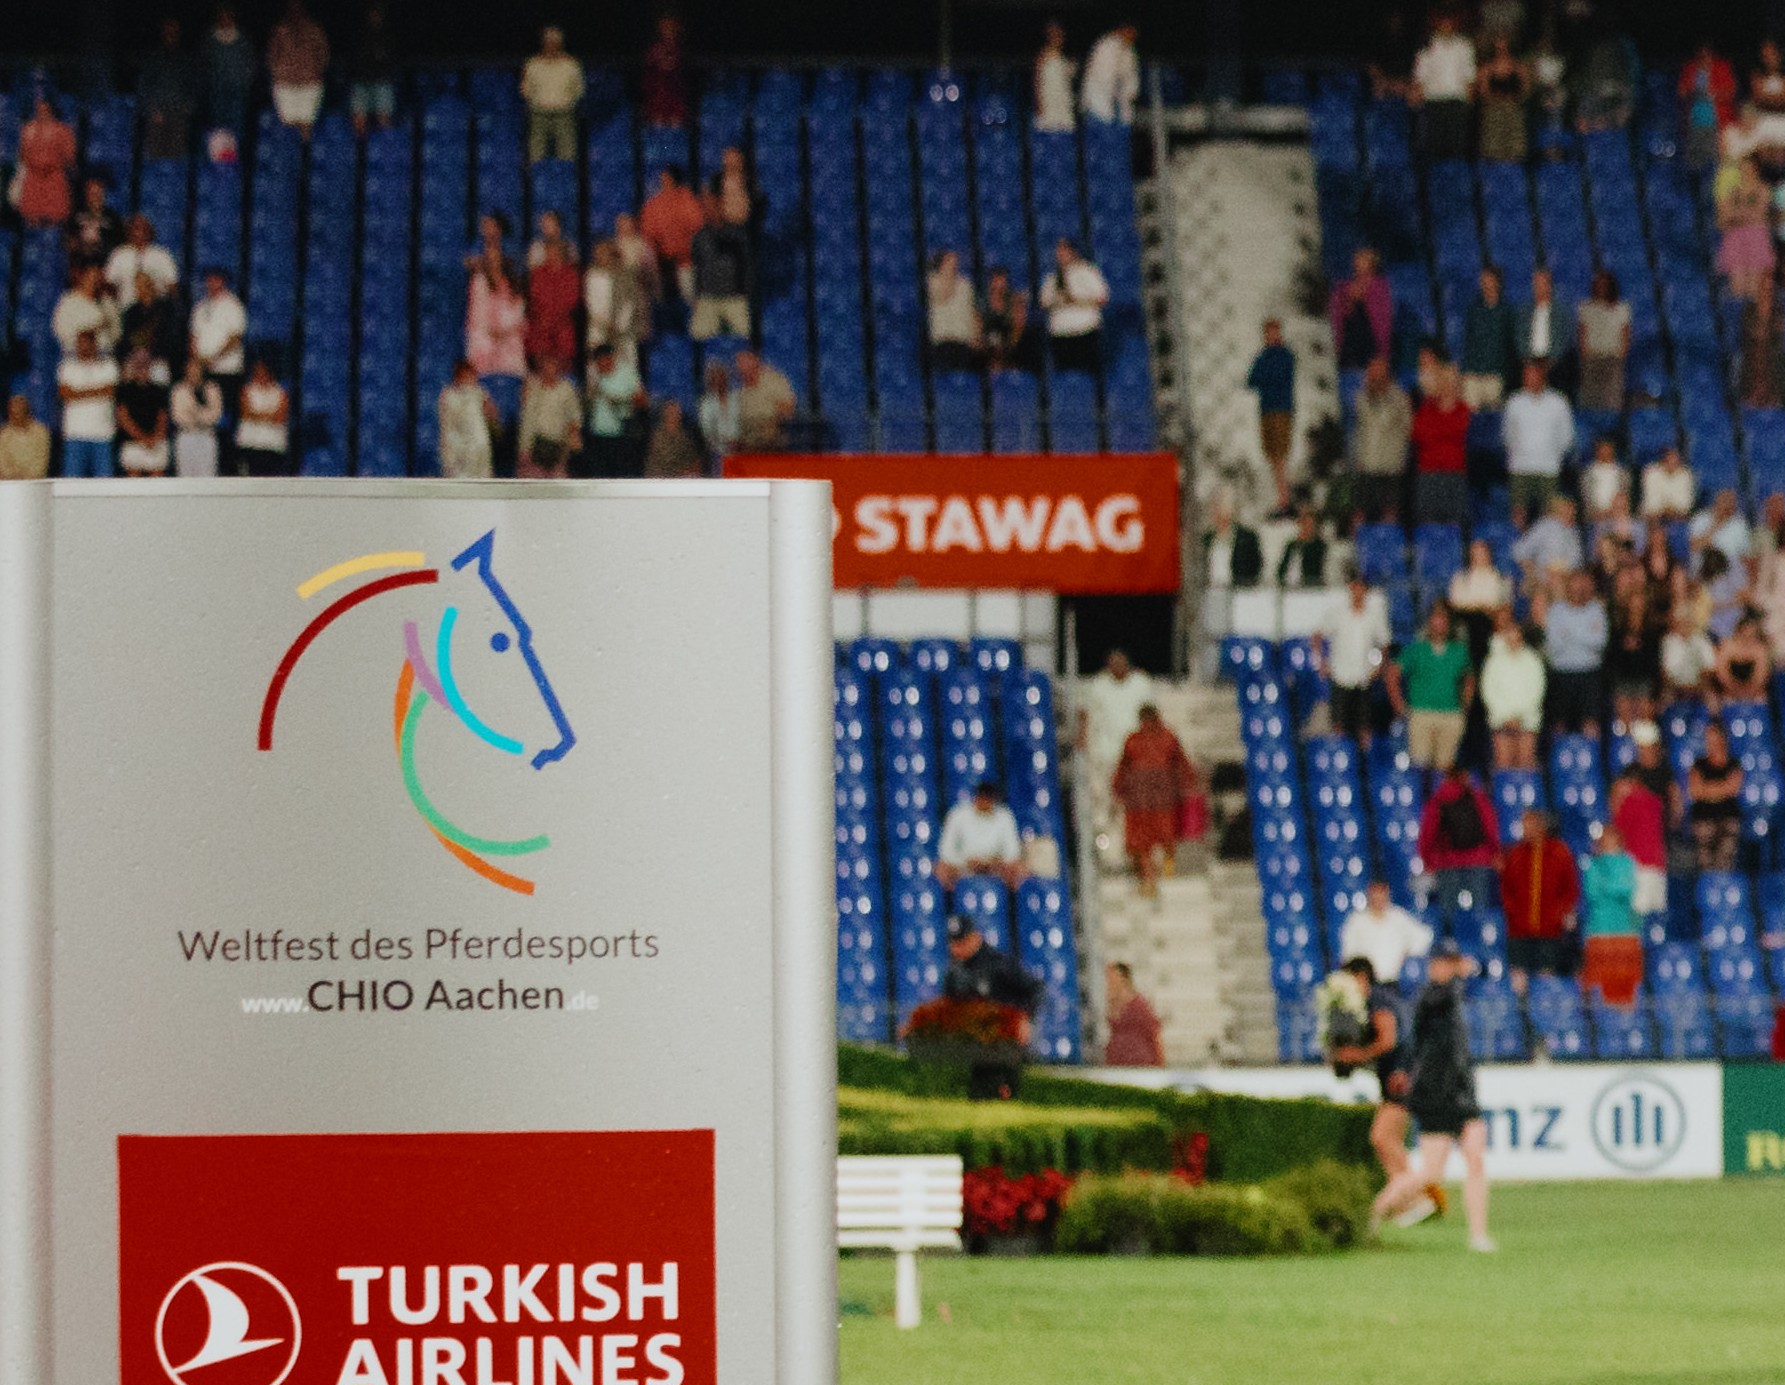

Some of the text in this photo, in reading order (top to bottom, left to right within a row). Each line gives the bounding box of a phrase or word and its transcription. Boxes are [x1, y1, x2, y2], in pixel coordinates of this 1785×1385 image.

[854, 494, 1145, 553] STAWAG
[178, 928, 659, 965] Weltfest des Pferdesports
[336, 1261, 679, 1326] TURKISH
